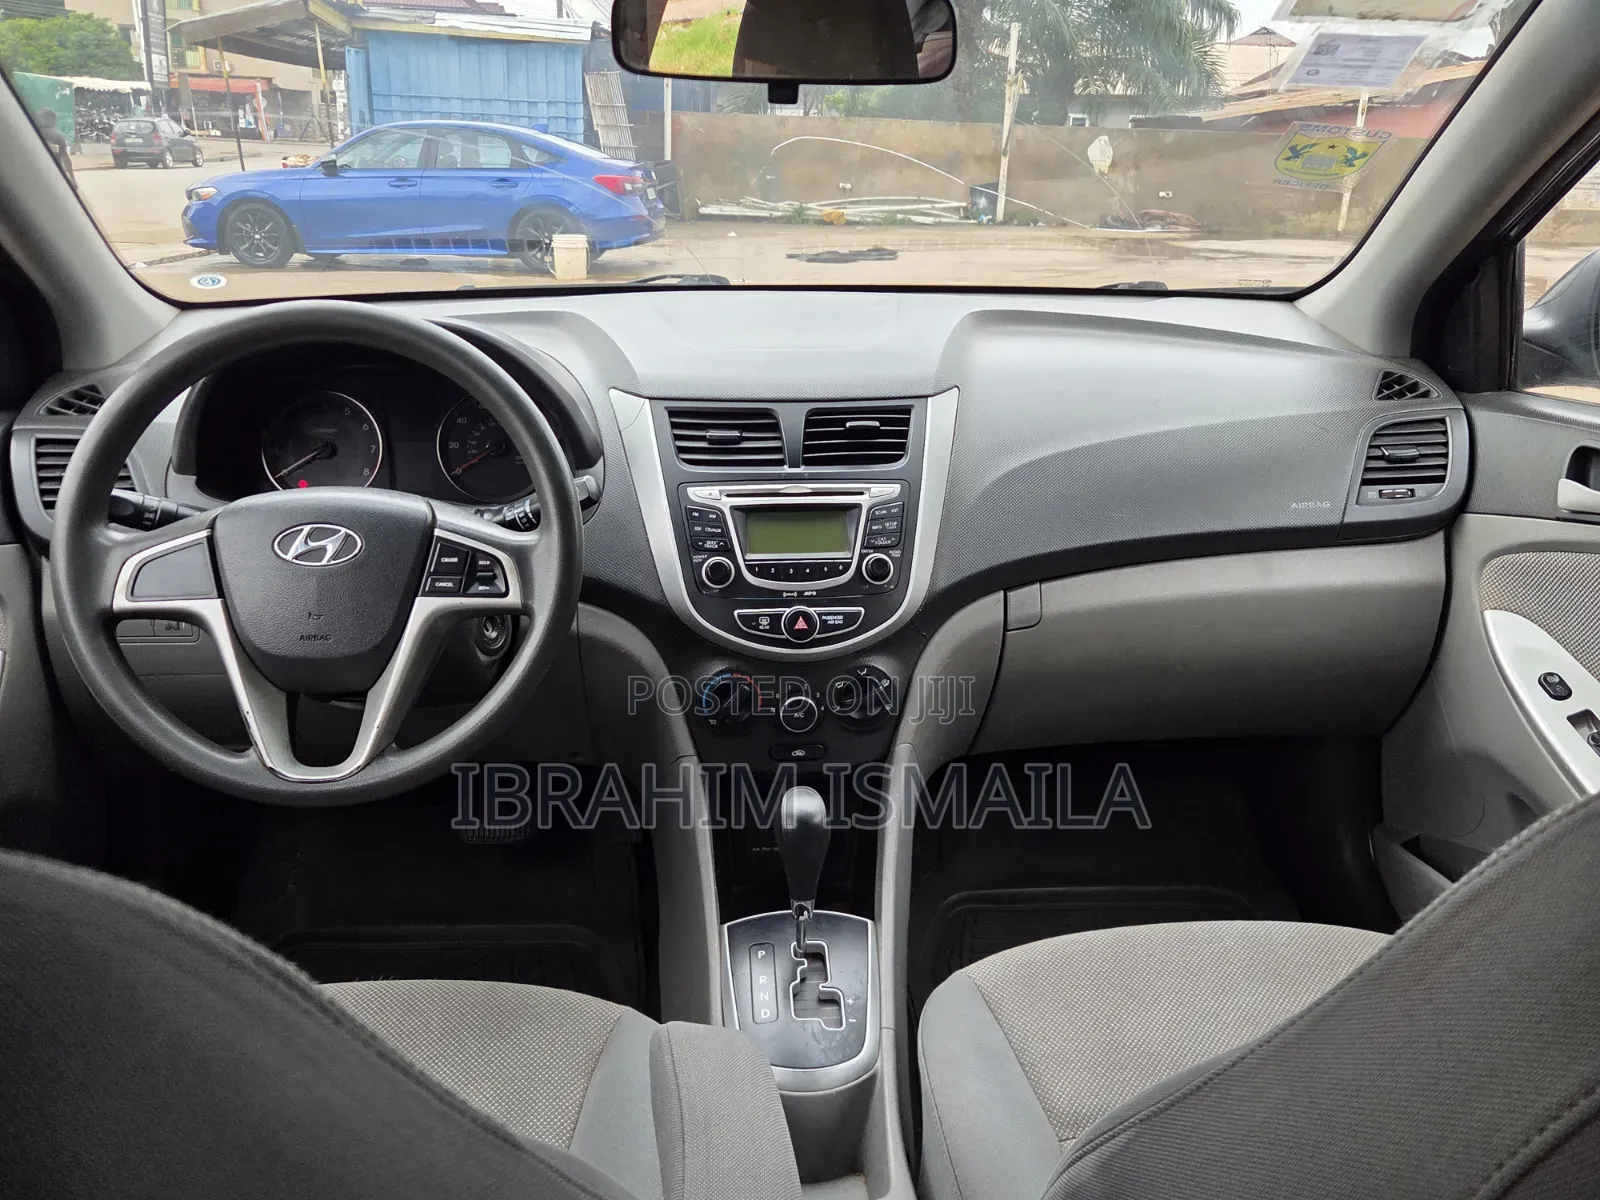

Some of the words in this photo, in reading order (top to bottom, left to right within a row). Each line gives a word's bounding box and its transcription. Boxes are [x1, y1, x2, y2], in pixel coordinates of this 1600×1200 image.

[344, 408, 350, 416] 5
[370, 445, 376, 453] 7
[1291, 501, 1331, 509] AIRBAG
[758, 950, 766, 958] P
[760, 976, 767, 984] R
[761, 992, 768, 1000] N
[761, 1009, 770, 1018] D
